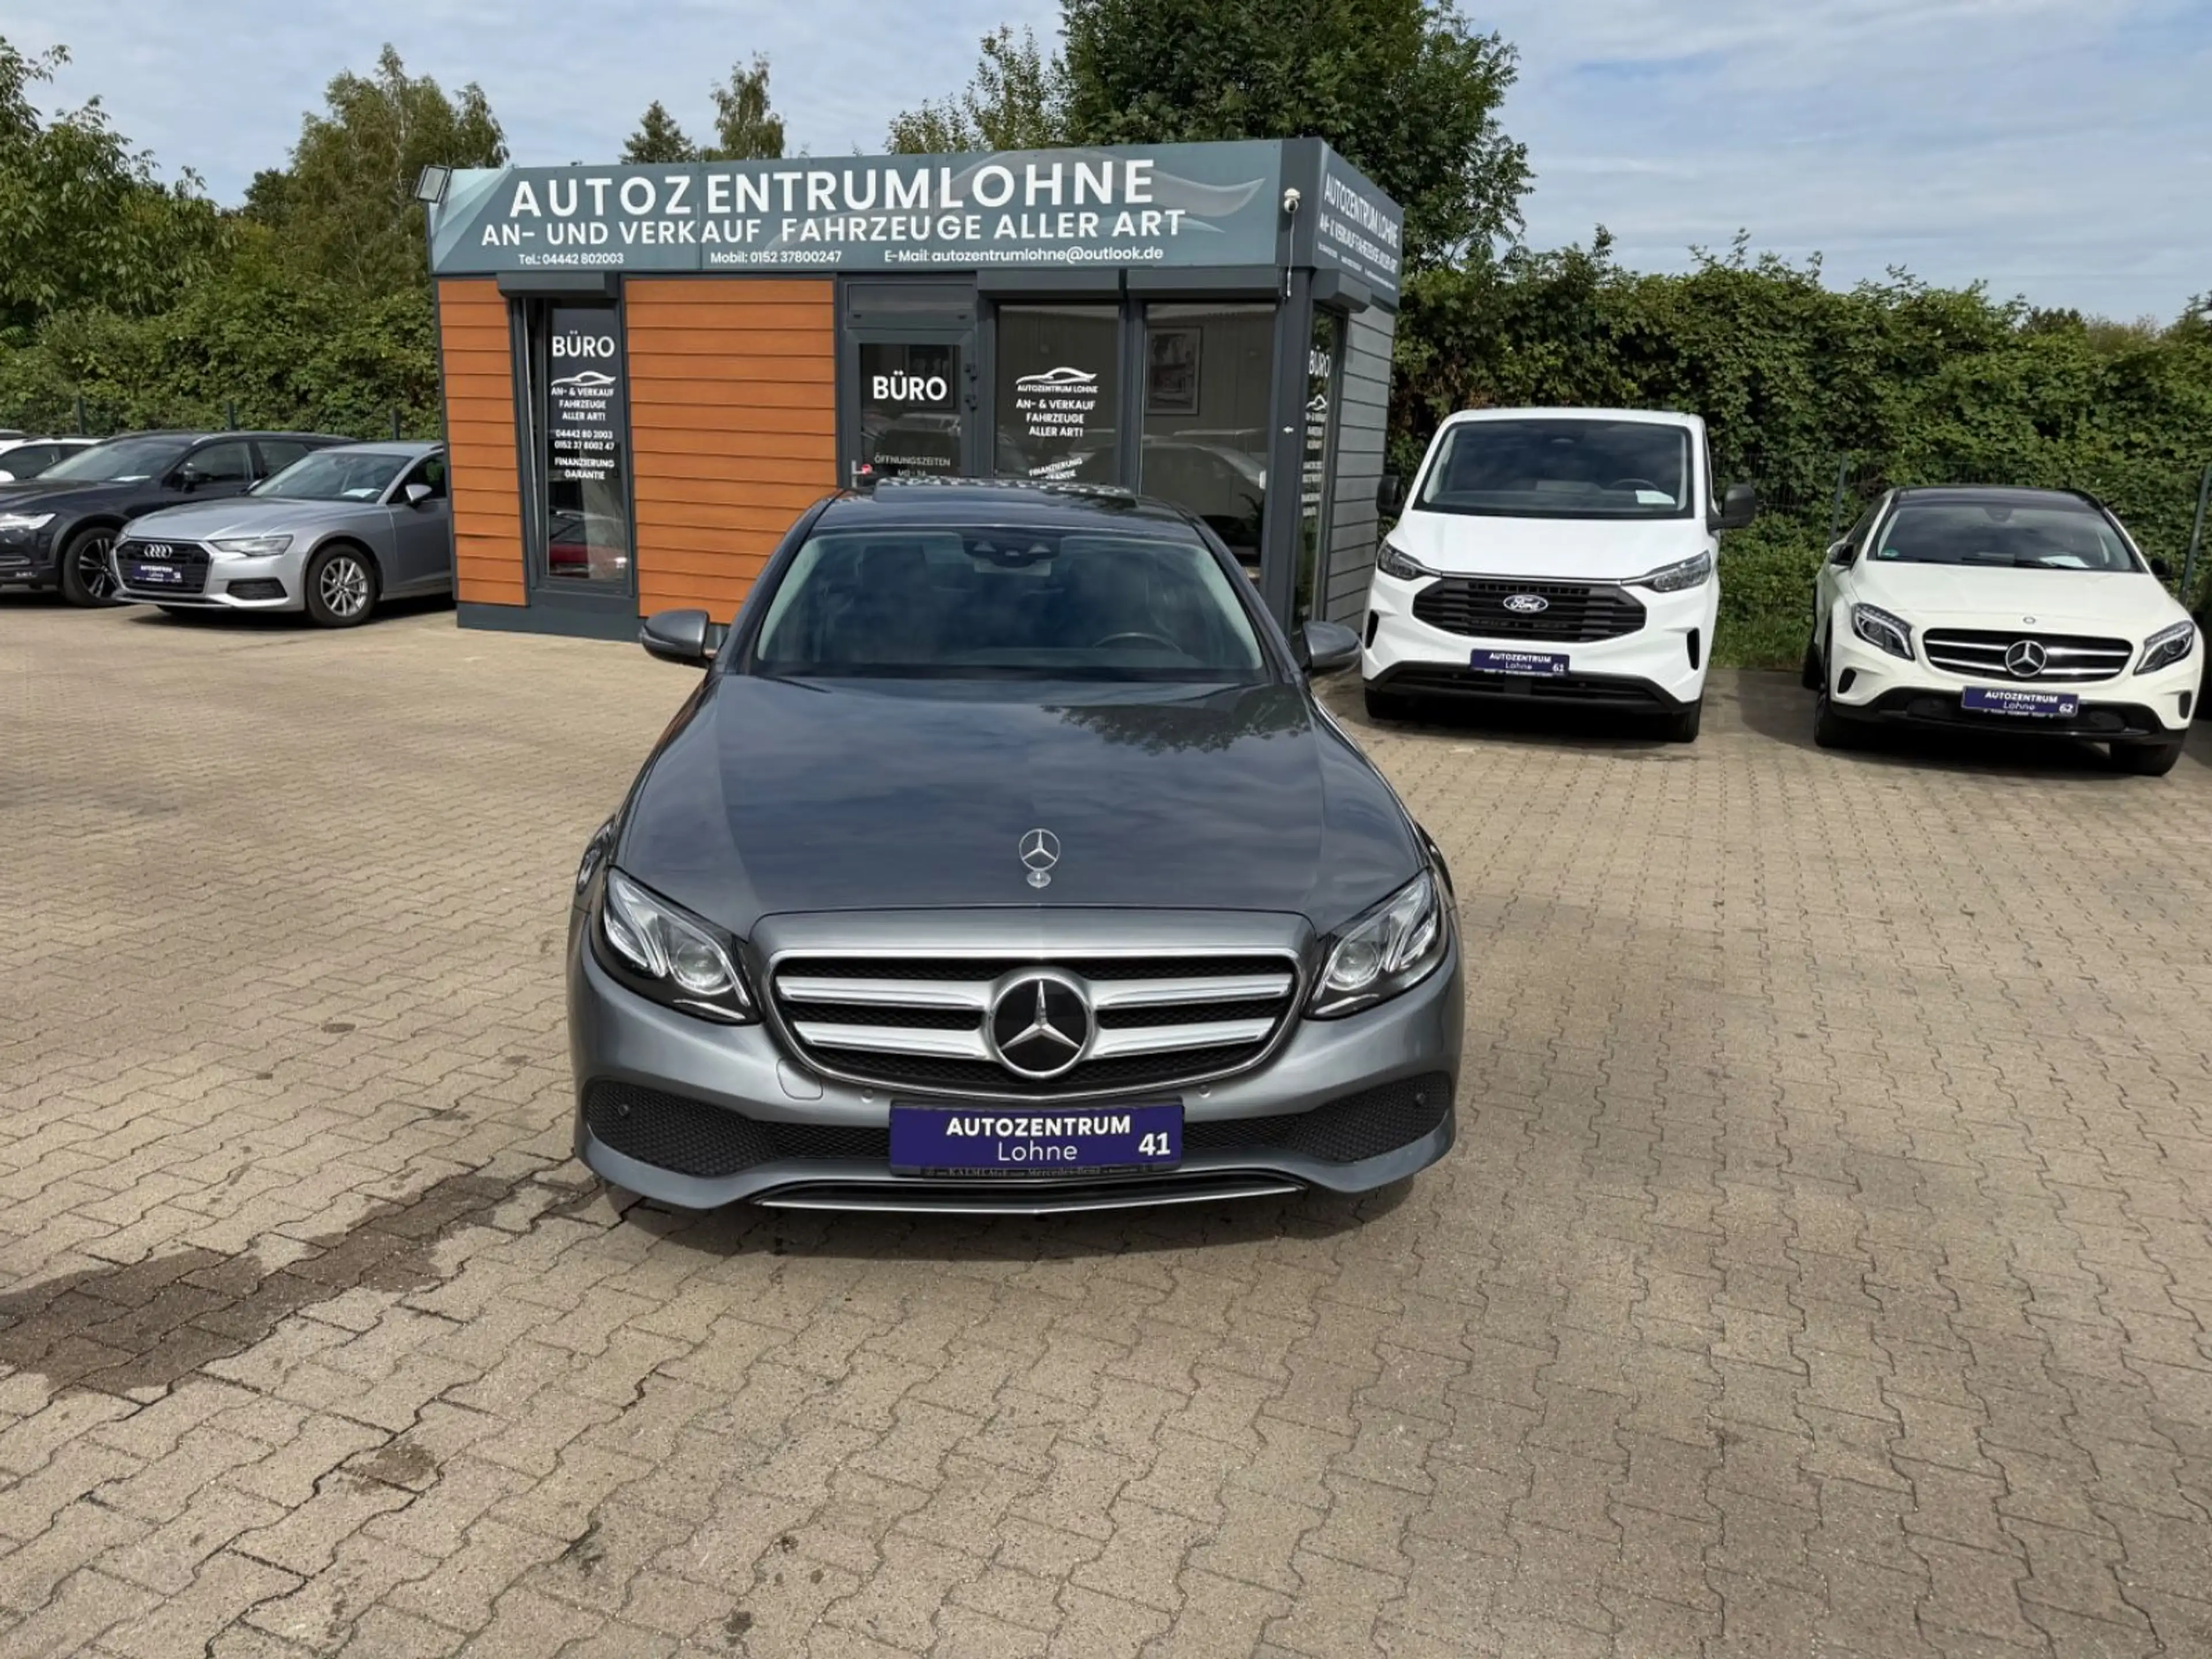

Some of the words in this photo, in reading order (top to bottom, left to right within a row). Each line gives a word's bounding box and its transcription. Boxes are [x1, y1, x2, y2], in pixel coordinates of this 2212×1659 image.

[482, 224, 535, 246] AN-
[547, 222, 608, 245] UND
[619, 219, 761, 245] VERKAUF
[782, 215, 980, 242] FAHRZEUGE
[993, 212, 1099, 240] ALLER
[1112, 209, 1185, 237] ART
[542, 253, 578, 265] 04442
[581, 252, 624, 264] 802003
[710, 251, 748, 264] Mobil:
[750, 251, 778, 263] 0152
[781, 250, 842, 263] 37800247
[552, 330, 615, 358] BÜRO
[873, 370, 948, 400] BÜRO
[1016, 399, 1036, 408] AN-
[1039, 399, 1047, 408] &
[1048, 399, 1096, 410] VERKAUF
[1026, 412, 1085, 424] FAHRZEUGE
[1028, 426, 1057, 437] ALLER
[1489, 652, 1552, 664] AUTOZENTRUM
[1984, 691, 2058, 703] AUTOZENTRUM
[2059, 703, 2074, 714] 62
[946, 1115, 1131, 1137] AUTOZENTRUM
[1138, 1132, 1171, 1156] 41
[998, 1141, 1078, 1162] Lohne
